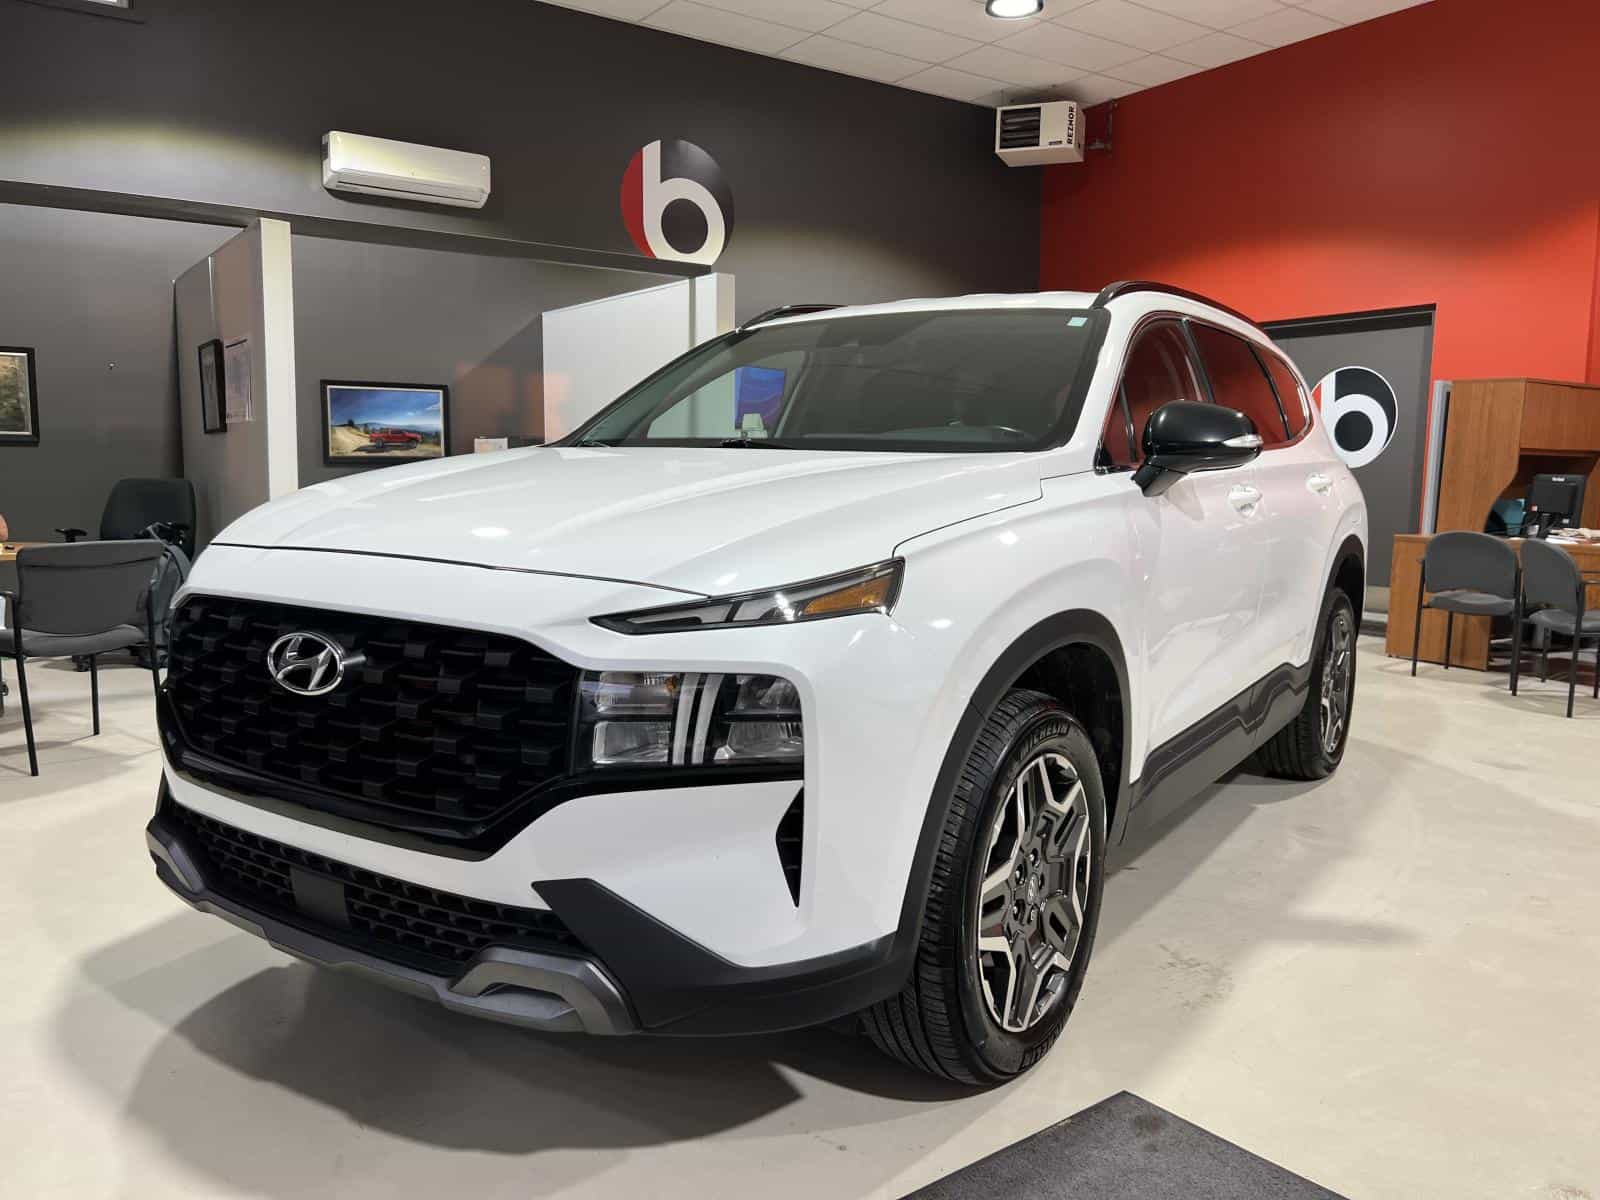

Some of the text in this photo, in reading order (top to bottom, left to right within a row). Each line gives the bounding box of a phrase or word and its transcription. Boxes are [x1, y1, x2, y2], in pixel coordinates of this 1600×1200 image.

[1067, 106, 1075, 145] REZNOR
[642, 139, 726, 266] b
[1320, 370, 1389, 469] b
